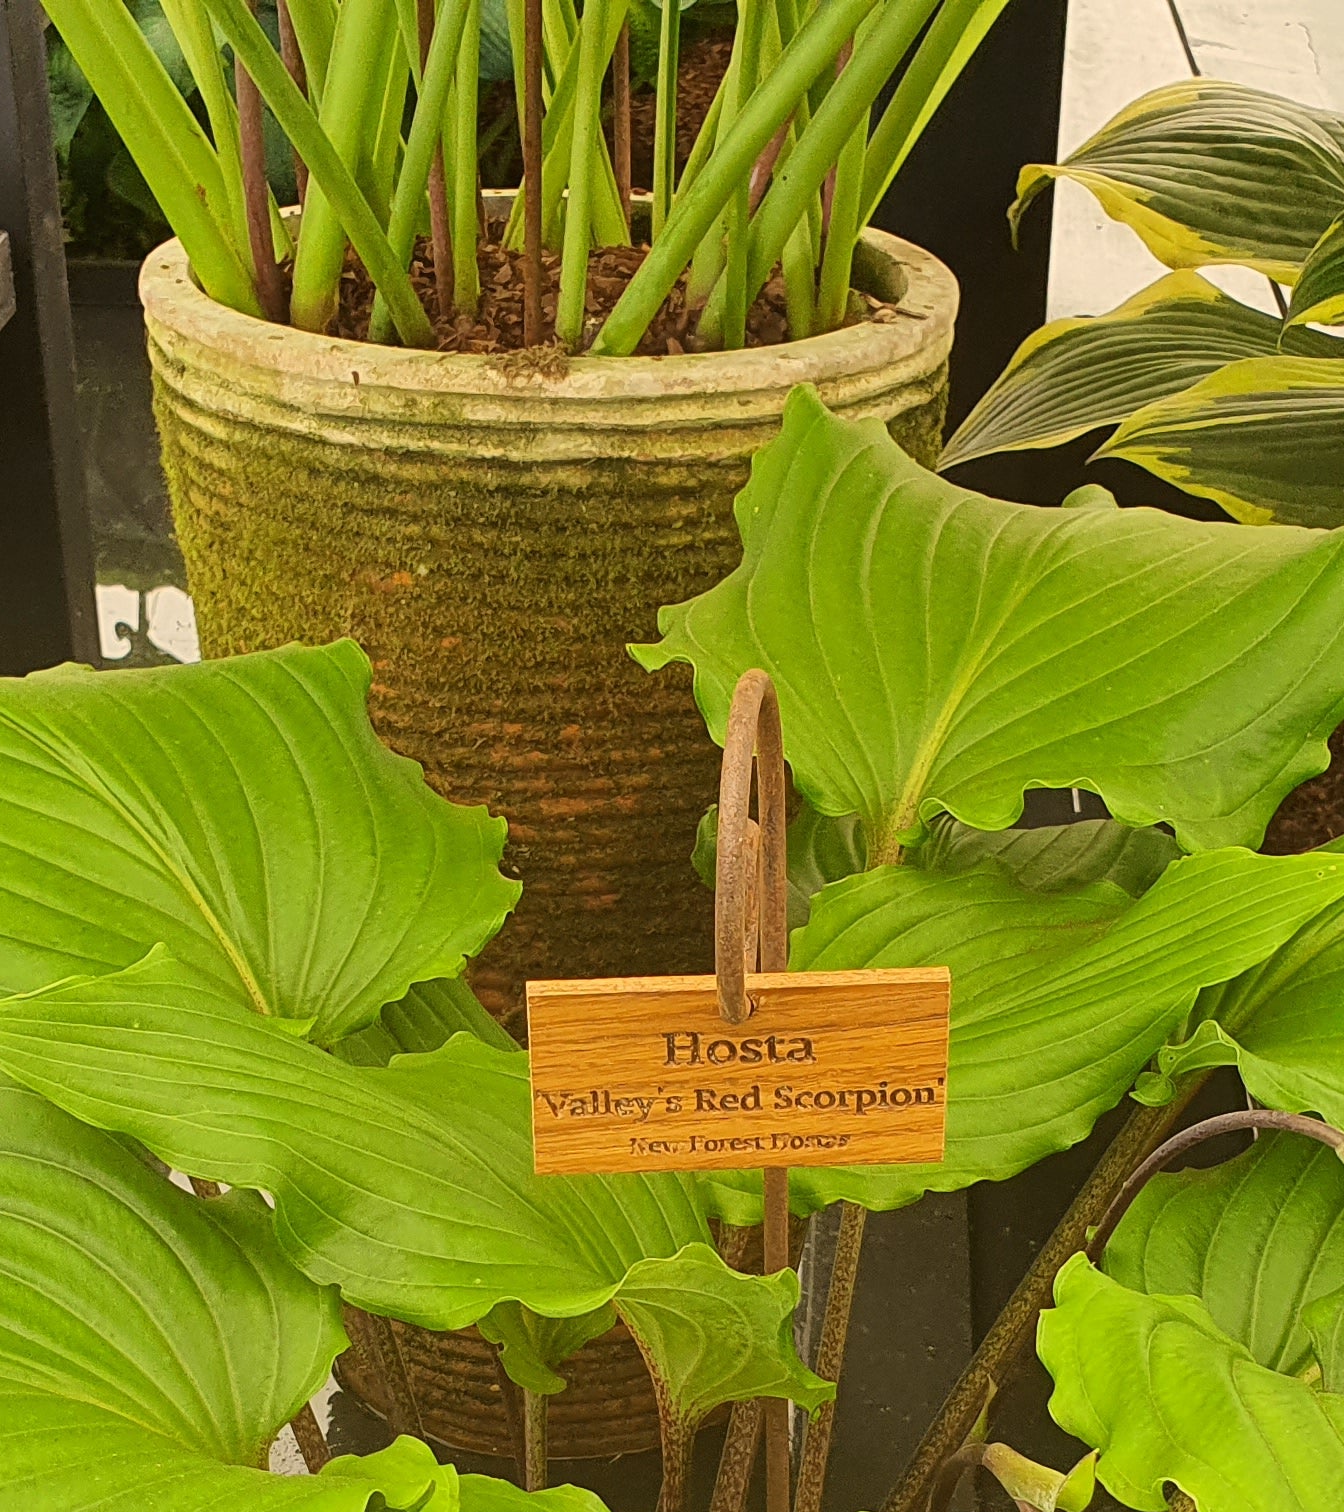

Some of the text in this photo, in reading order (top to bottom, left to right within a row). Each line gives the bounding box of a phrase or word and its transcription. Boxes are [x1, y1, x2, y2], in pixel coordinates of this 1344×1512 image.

[662, 1031, 817, 1066] Hosta
[694, 1087, 761, 1113] Red
[773, 1077, 946, 1118] Scorpion'
[630, 1136, 678, 1157] New
[688, 1134, 761, 1155] Forest
